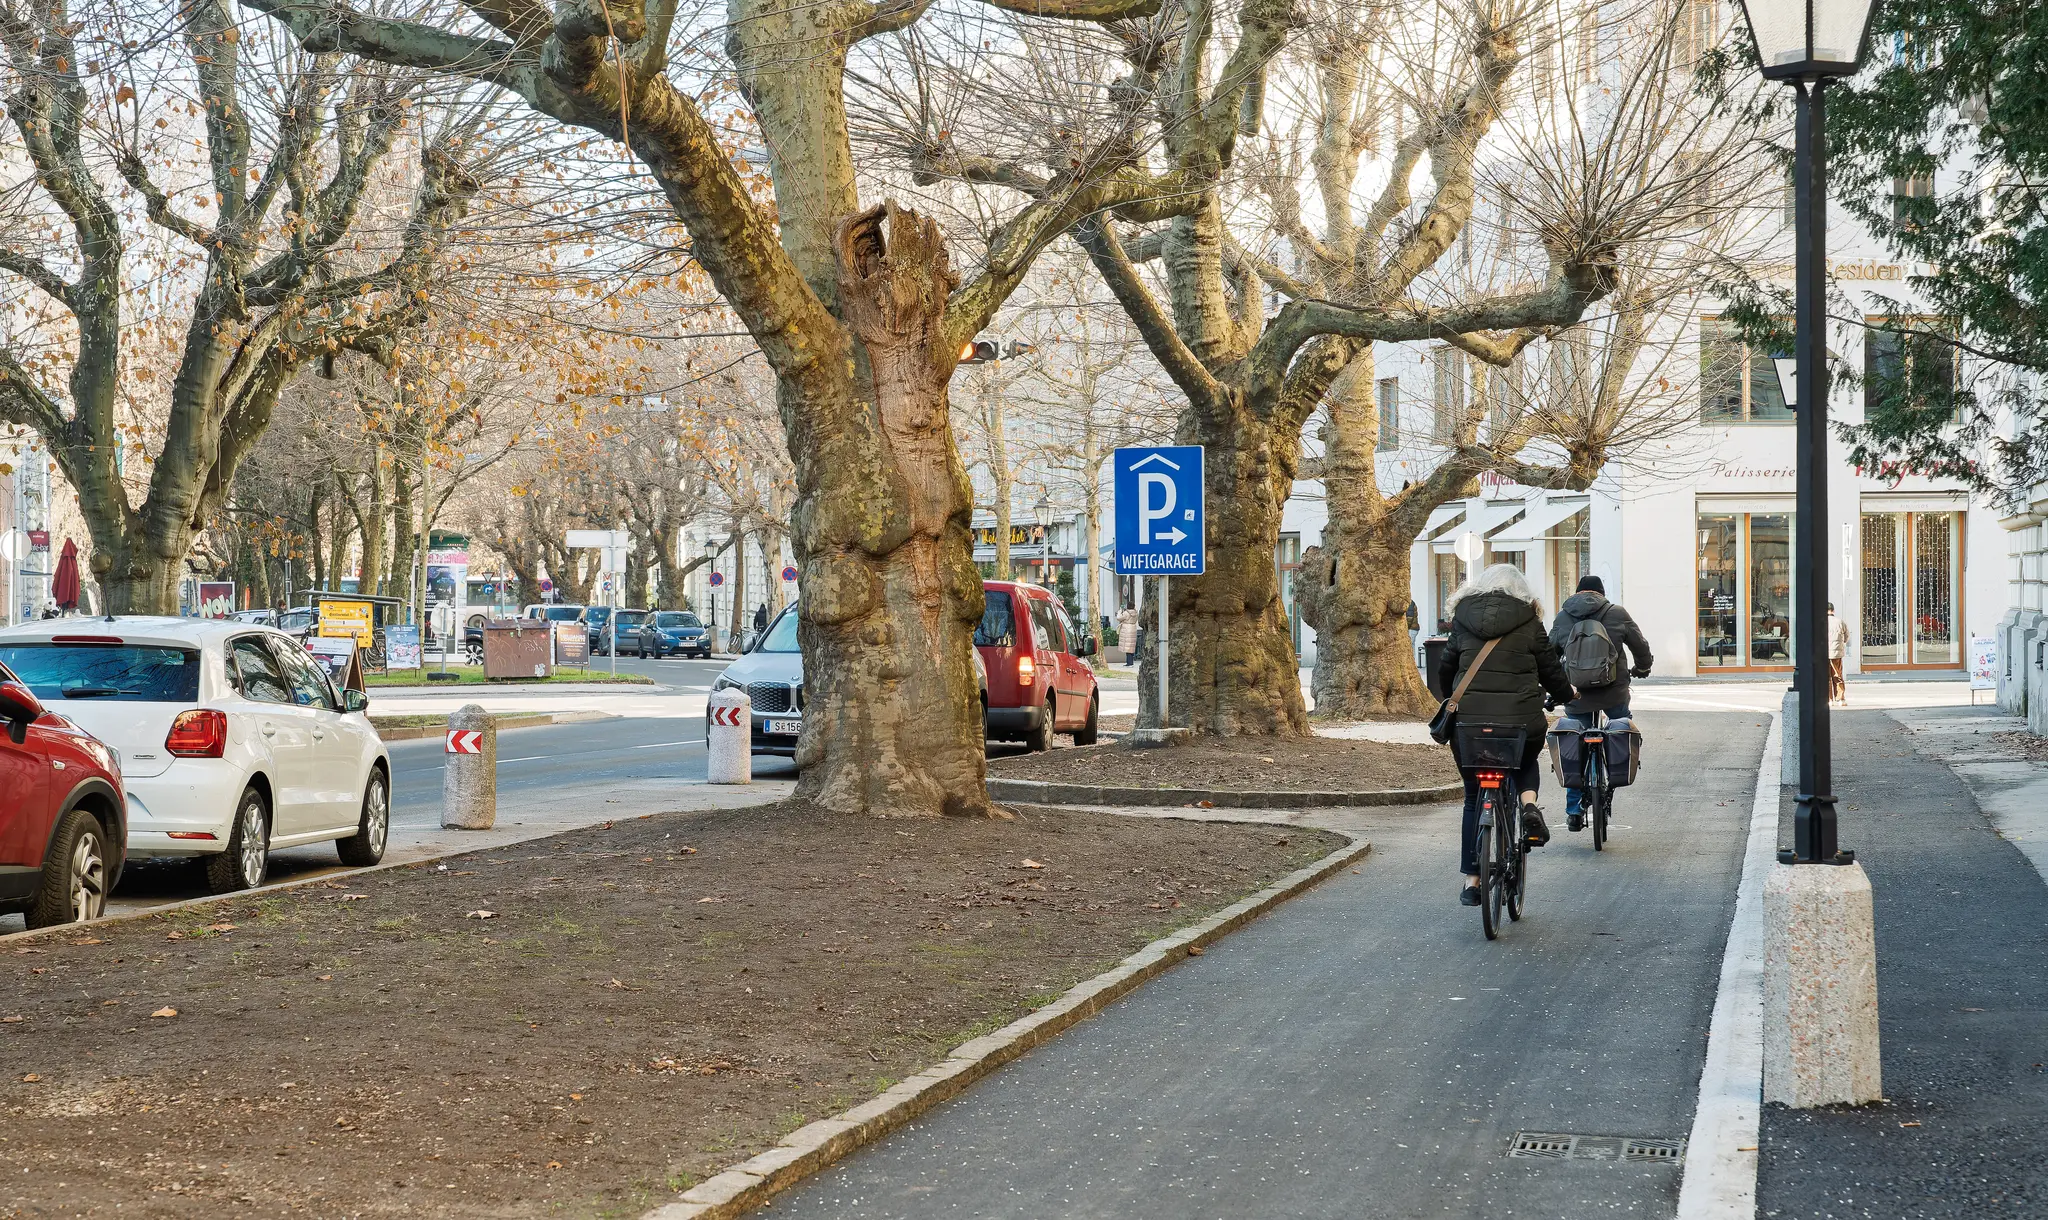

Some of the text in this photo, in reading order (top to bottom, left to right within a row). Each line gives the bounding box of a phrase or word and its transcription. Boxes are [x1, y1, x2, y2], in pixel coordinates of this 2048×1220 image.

[1825, 258, 1911, 281] esiden
[1711, 462, 1797, 478] Patisserie
[1139, 473, 1177, 545] P
[1122, 553, 1197, 569] WIFIGARAGE
